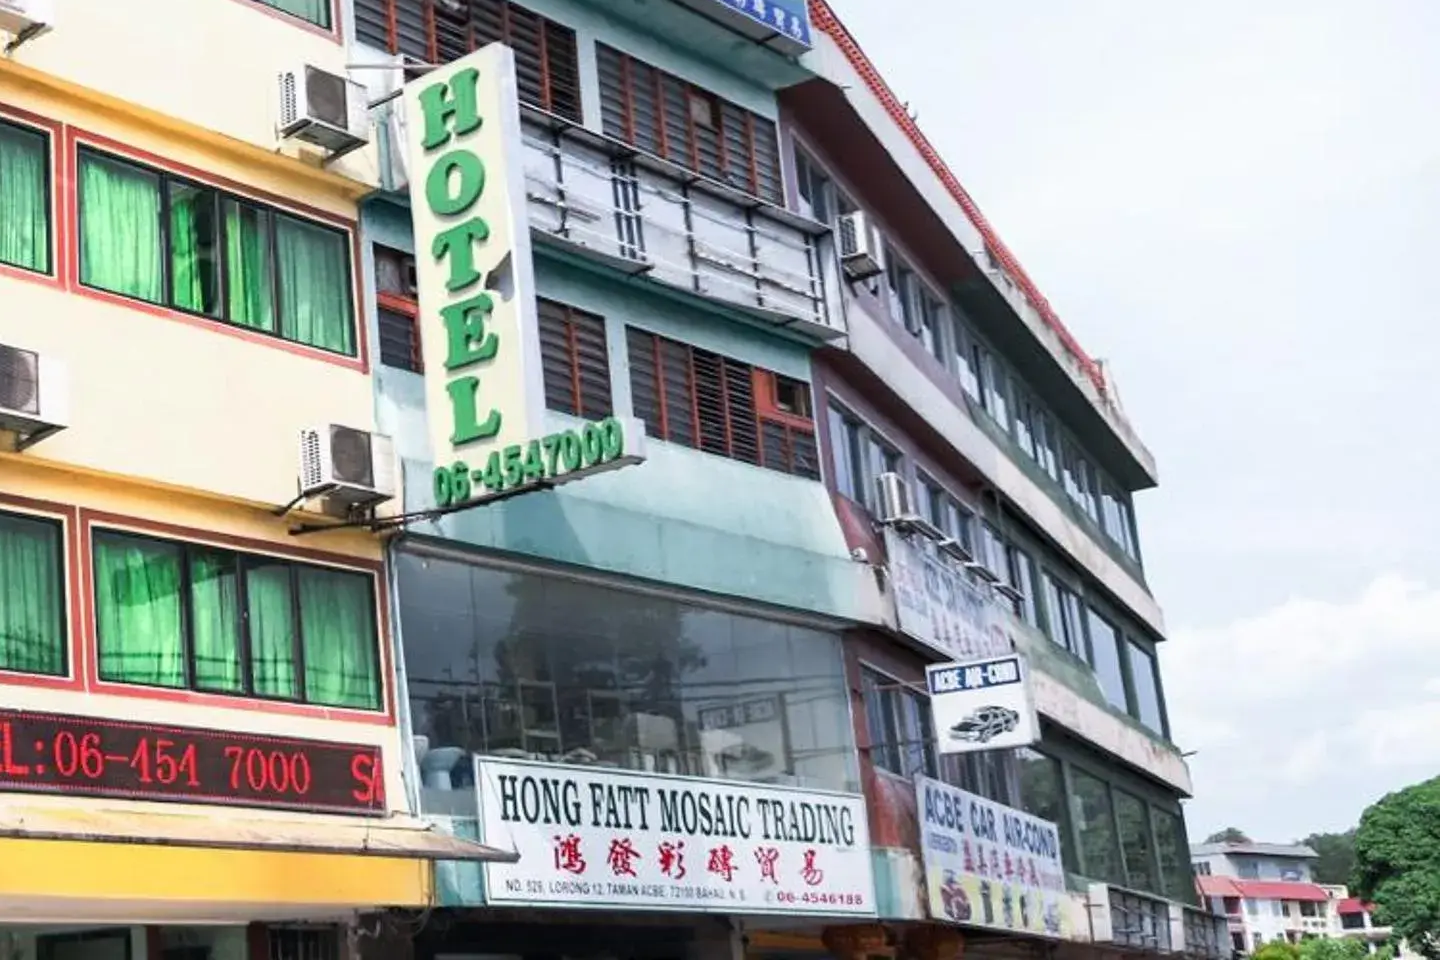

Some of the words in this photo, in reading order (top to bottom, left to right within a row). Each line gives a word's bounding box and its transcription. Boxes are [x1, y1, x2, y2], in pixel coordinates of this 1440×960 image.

[418, 67, 502, 445] HOTEL
[433, 416, 624, 507] 06-4547000
[224, 745, 311, 795] 7000
[498, 775, 581, 826] HONG
[589, 782, 650, 830] FATT
[657, 788, 751, 839] MOSAIC
[757, 798, 854, 846] TRADING
[924, 785, 964, 833] ACBE
[970, 801, 997, 843] CAR
